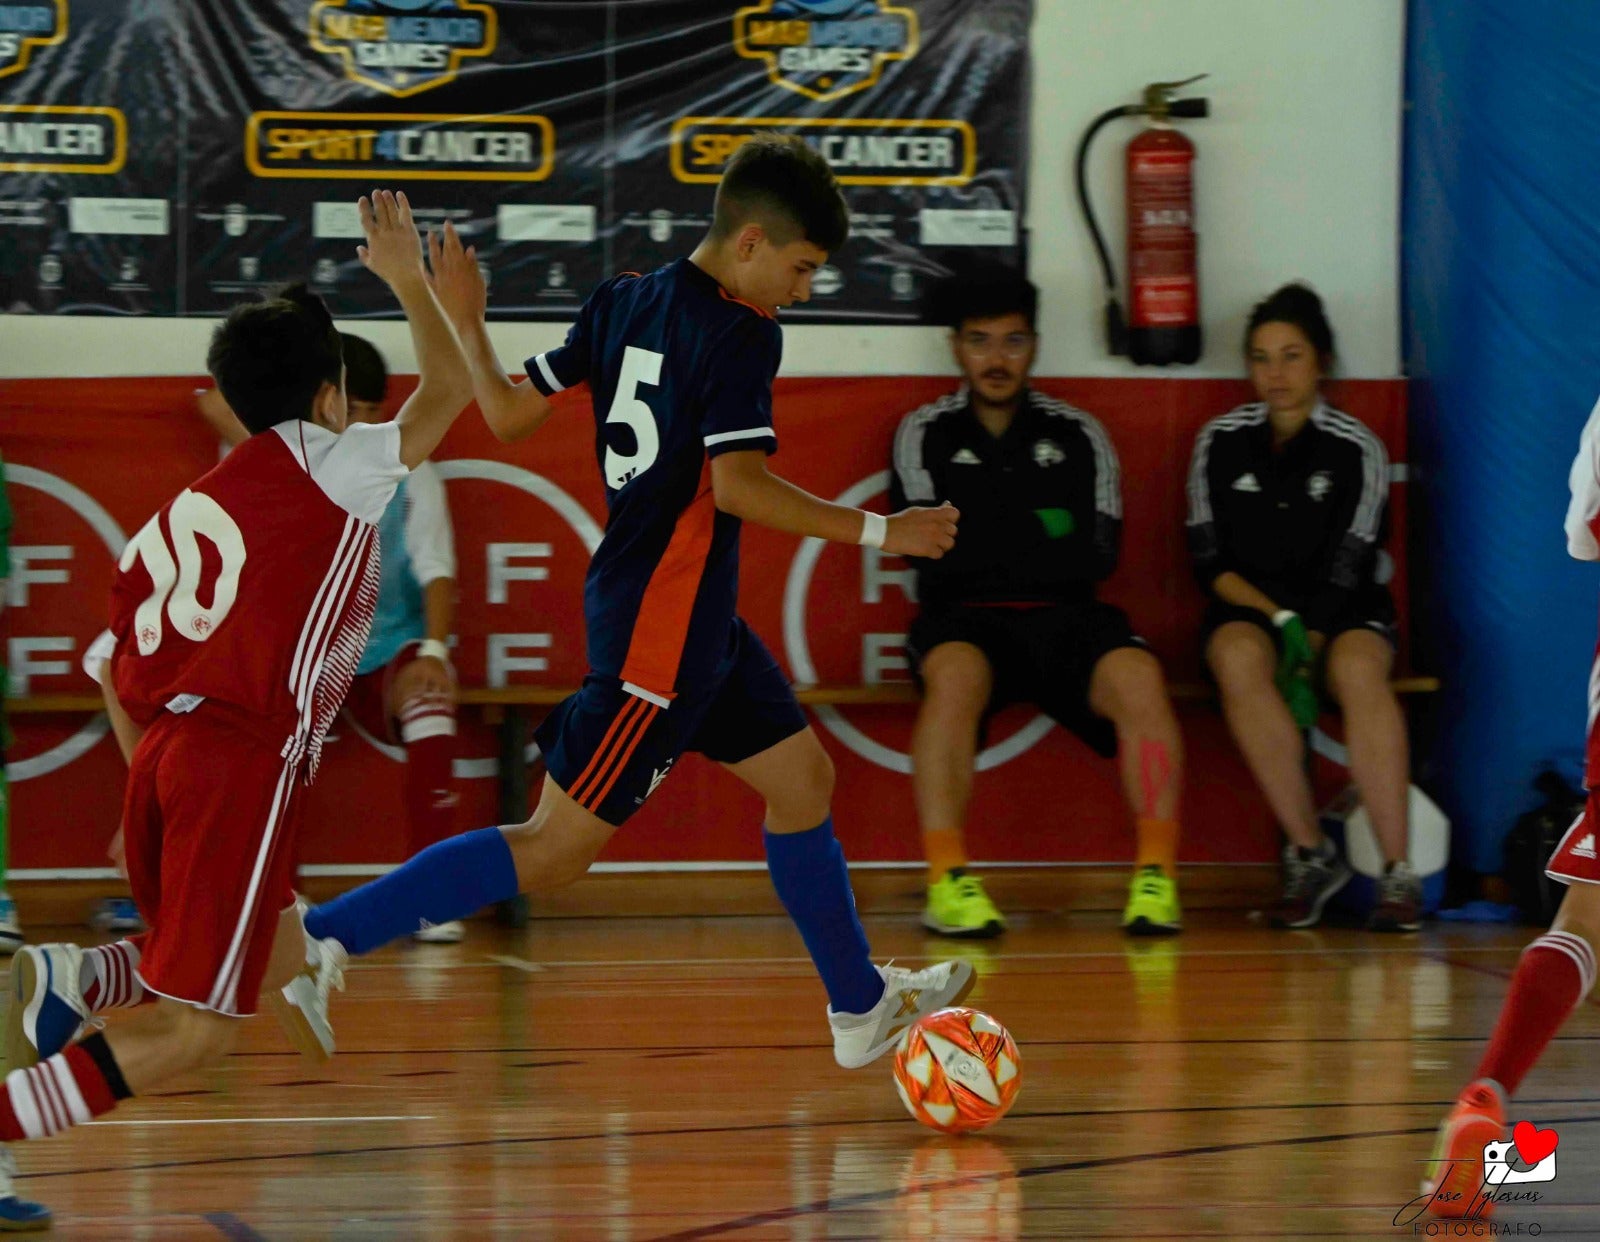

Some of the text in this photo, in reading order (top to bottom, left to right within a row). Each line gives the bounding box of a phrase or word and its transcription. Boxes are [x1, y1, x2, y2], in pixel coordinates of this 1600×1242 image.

[605, 345, 664, 490] 5
[118, 487, 247, 656] 10
[487, 542, 552, 604] F
